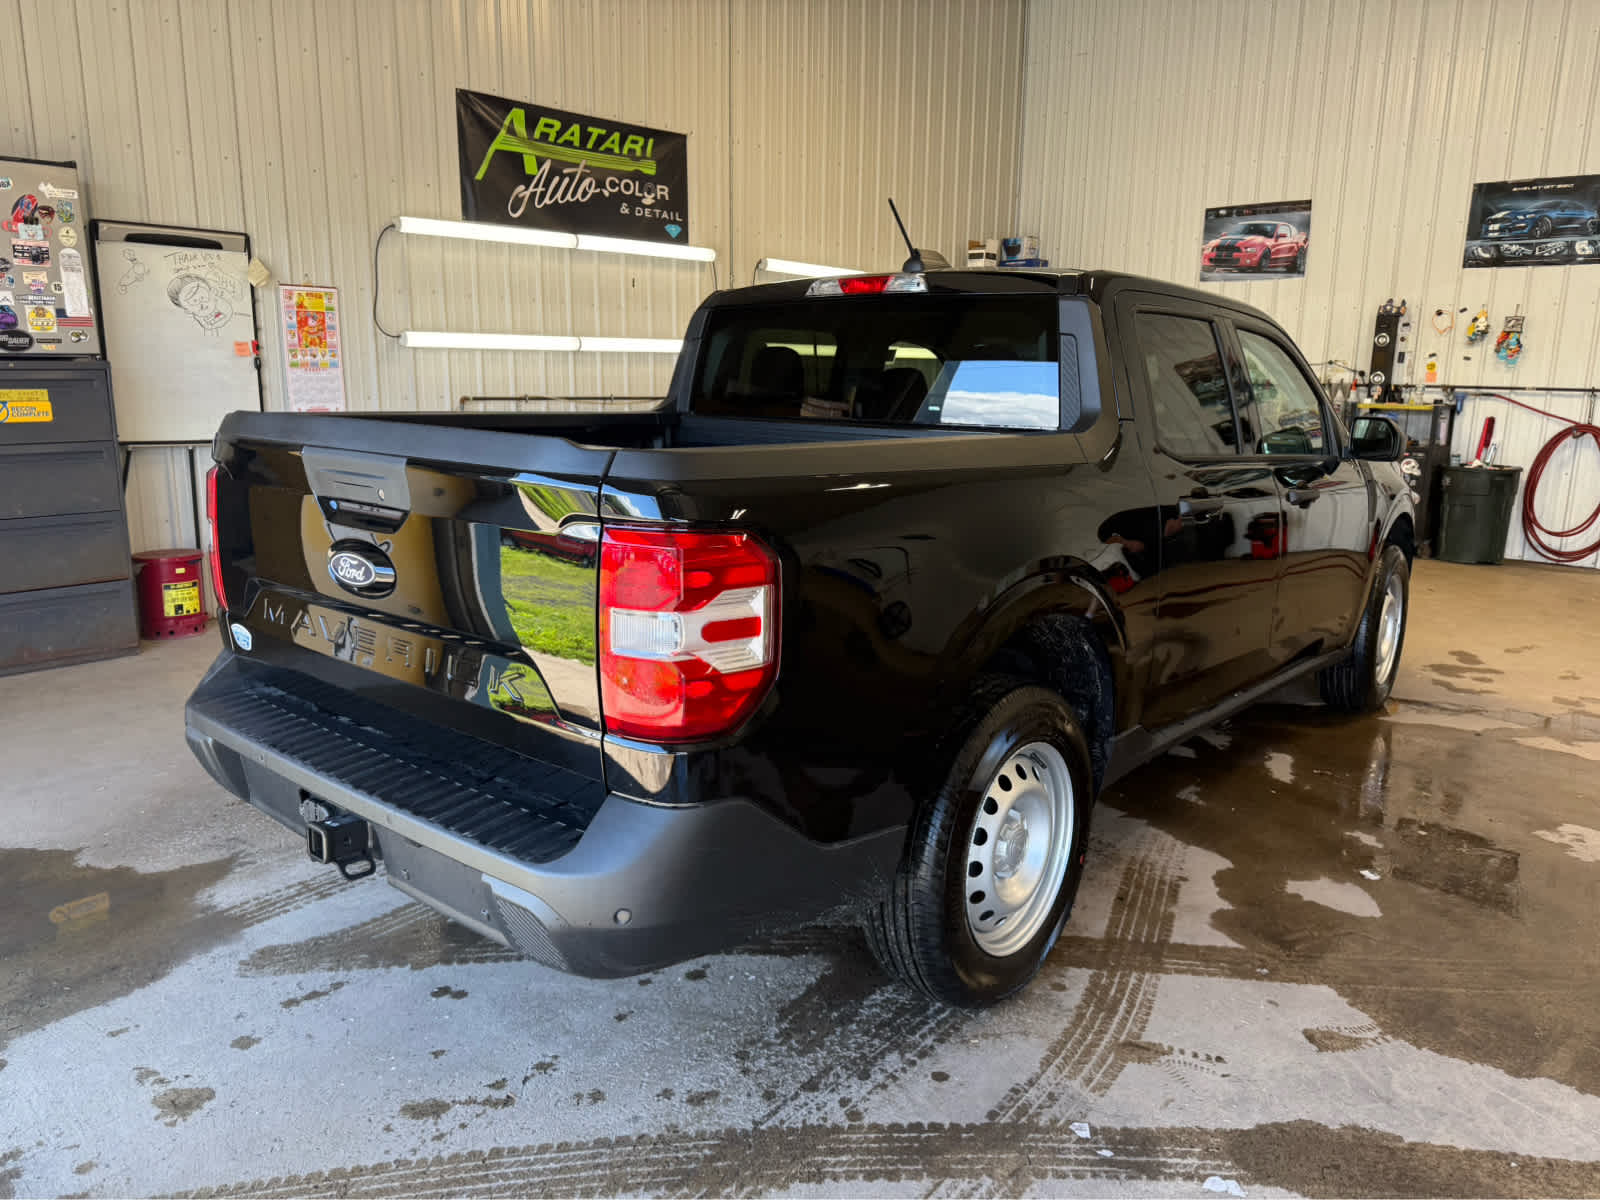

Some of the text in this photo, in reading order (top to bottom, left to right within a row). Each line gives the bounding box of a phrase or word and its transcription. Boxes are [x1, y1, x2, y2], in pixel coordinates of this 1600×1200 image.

[475, 107, 654, 181] ARATARI
[508, 158, 601, 218] Auto
[620, 202, 683, 222] & DETAIL
[337, 559, 366, 582] Ford
[262, 598, 526, 702] MAVERICK
